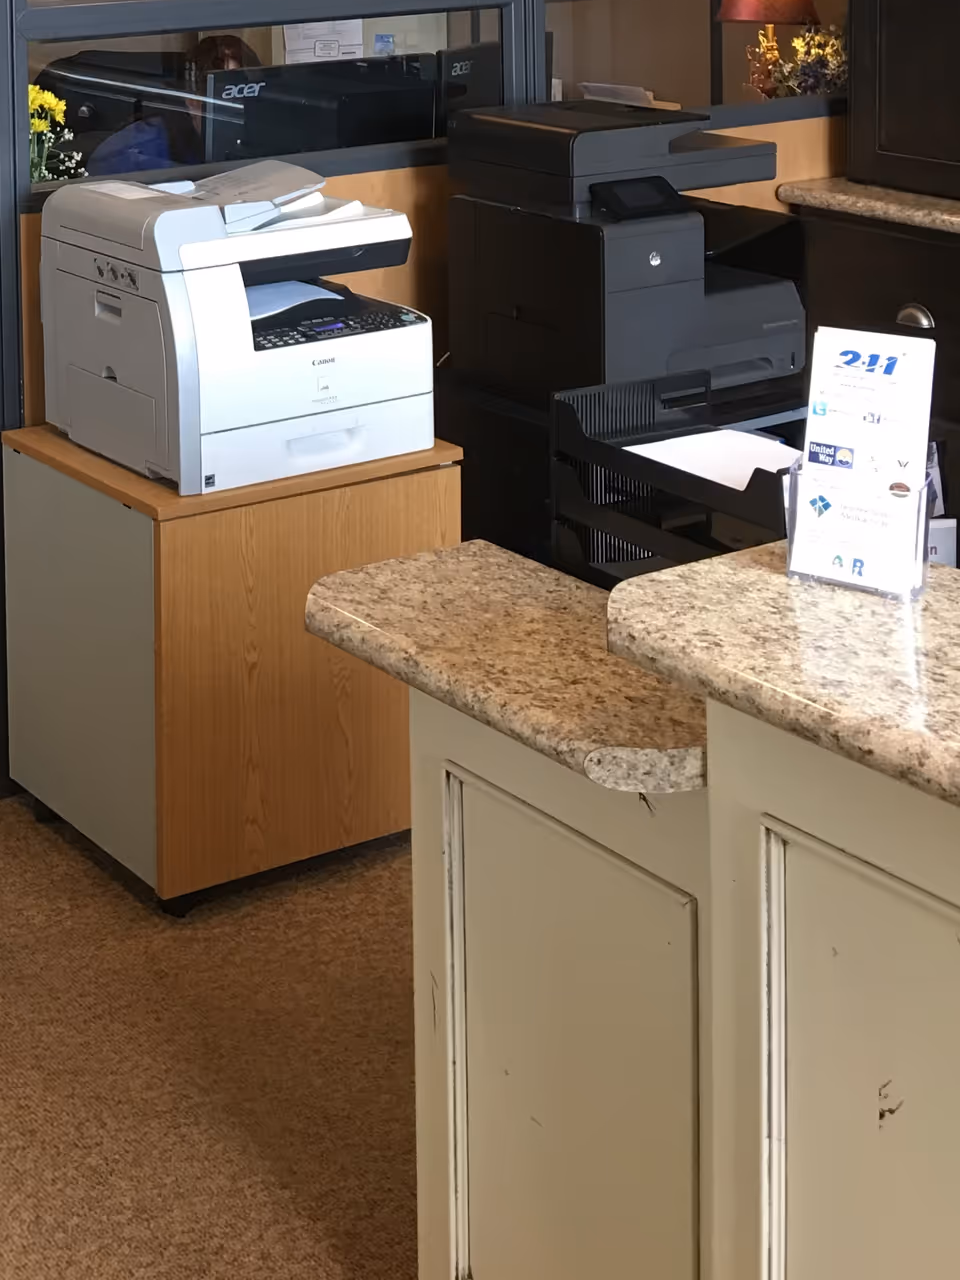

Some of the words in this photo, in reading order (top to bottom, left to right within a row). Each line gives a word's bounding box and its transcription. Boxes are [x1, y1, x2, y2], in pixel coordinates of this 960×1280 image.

[221, 82, 266, 99] acer
[311, 357, 336, 366] Canon
[810, 443, 835, 456] United
[818, 453, 834, 465] Way
